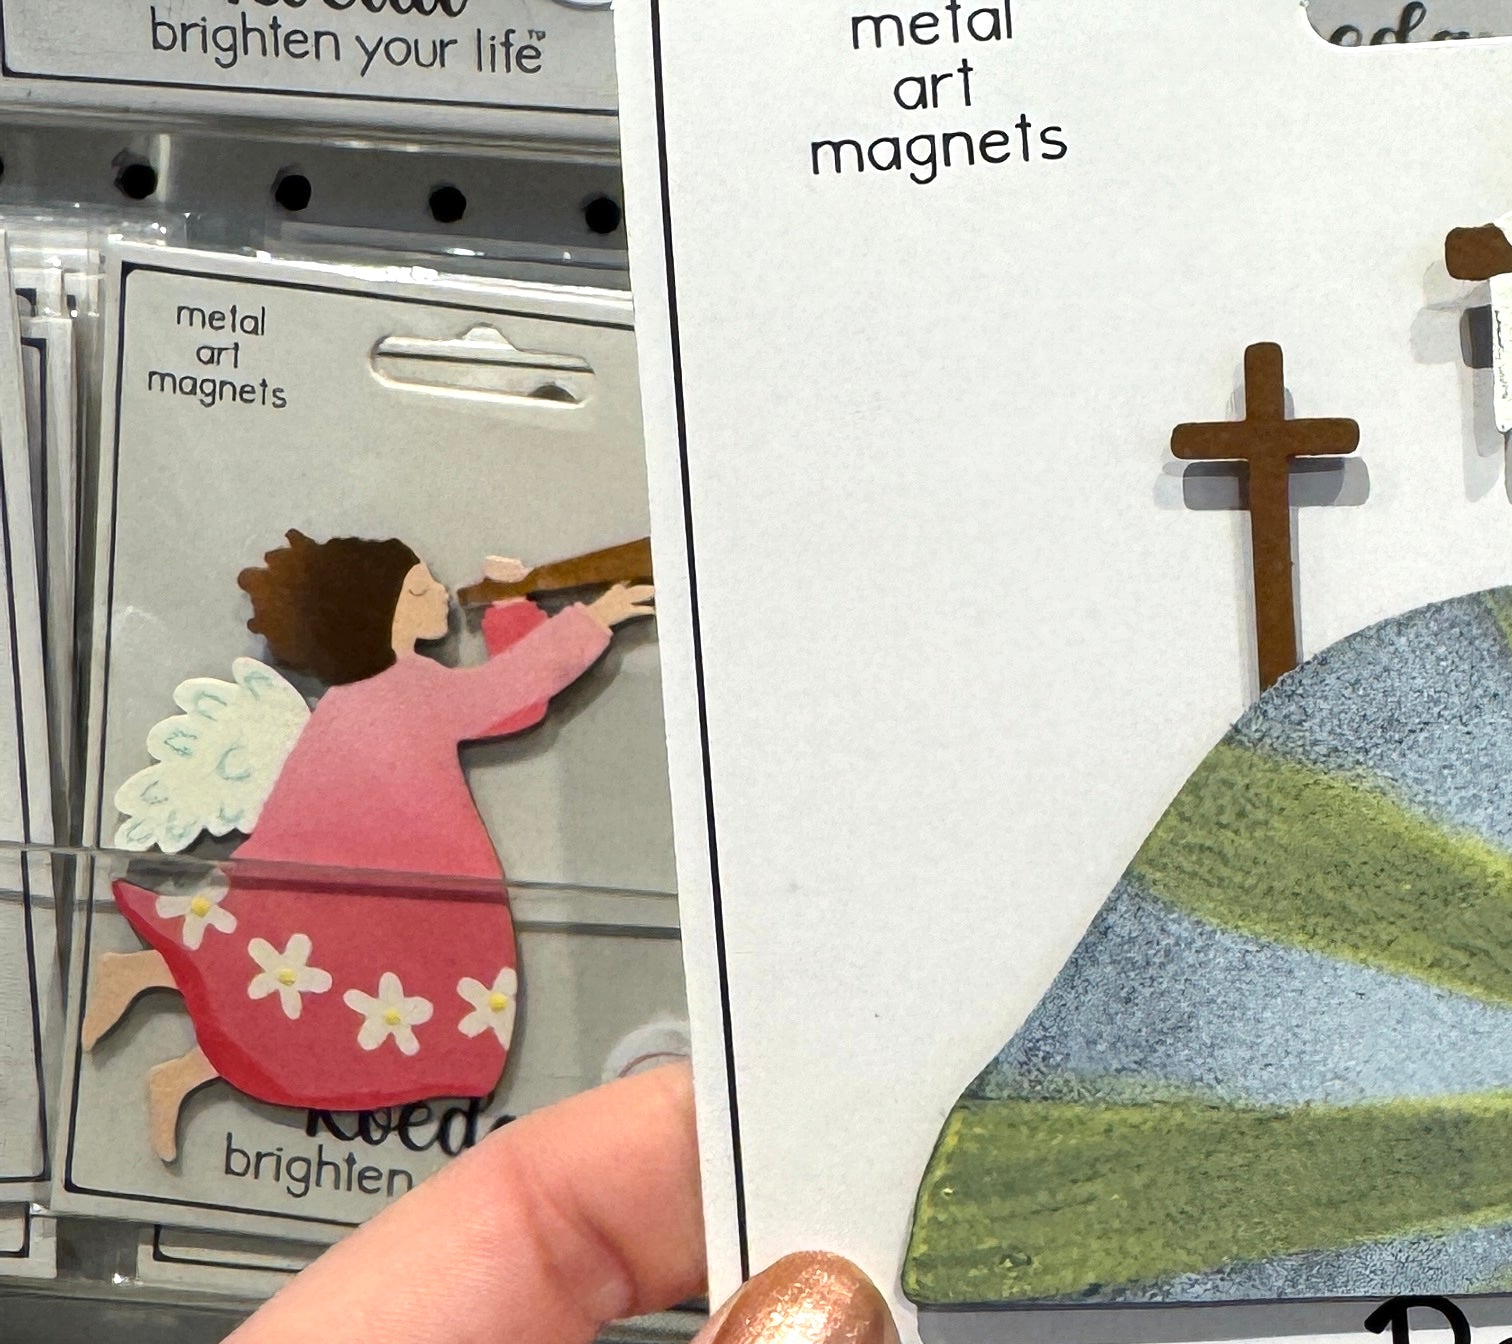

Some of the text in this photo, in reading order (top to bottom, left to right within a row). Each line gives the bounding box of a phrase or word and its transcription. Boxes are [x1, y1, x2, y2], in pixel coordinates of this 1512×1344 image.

[151, 6, 341, 69] brighten
[355, 36, 458, 77] your
[893, 58, 974, 110] art
[811, 113, 1068, 184] magnets
[176, 304, 266, 336] metal
[196, 341, 239, 368] art
[148, 369, 288, 408] magnets
[224, 1132, 414, 1198] brighten
